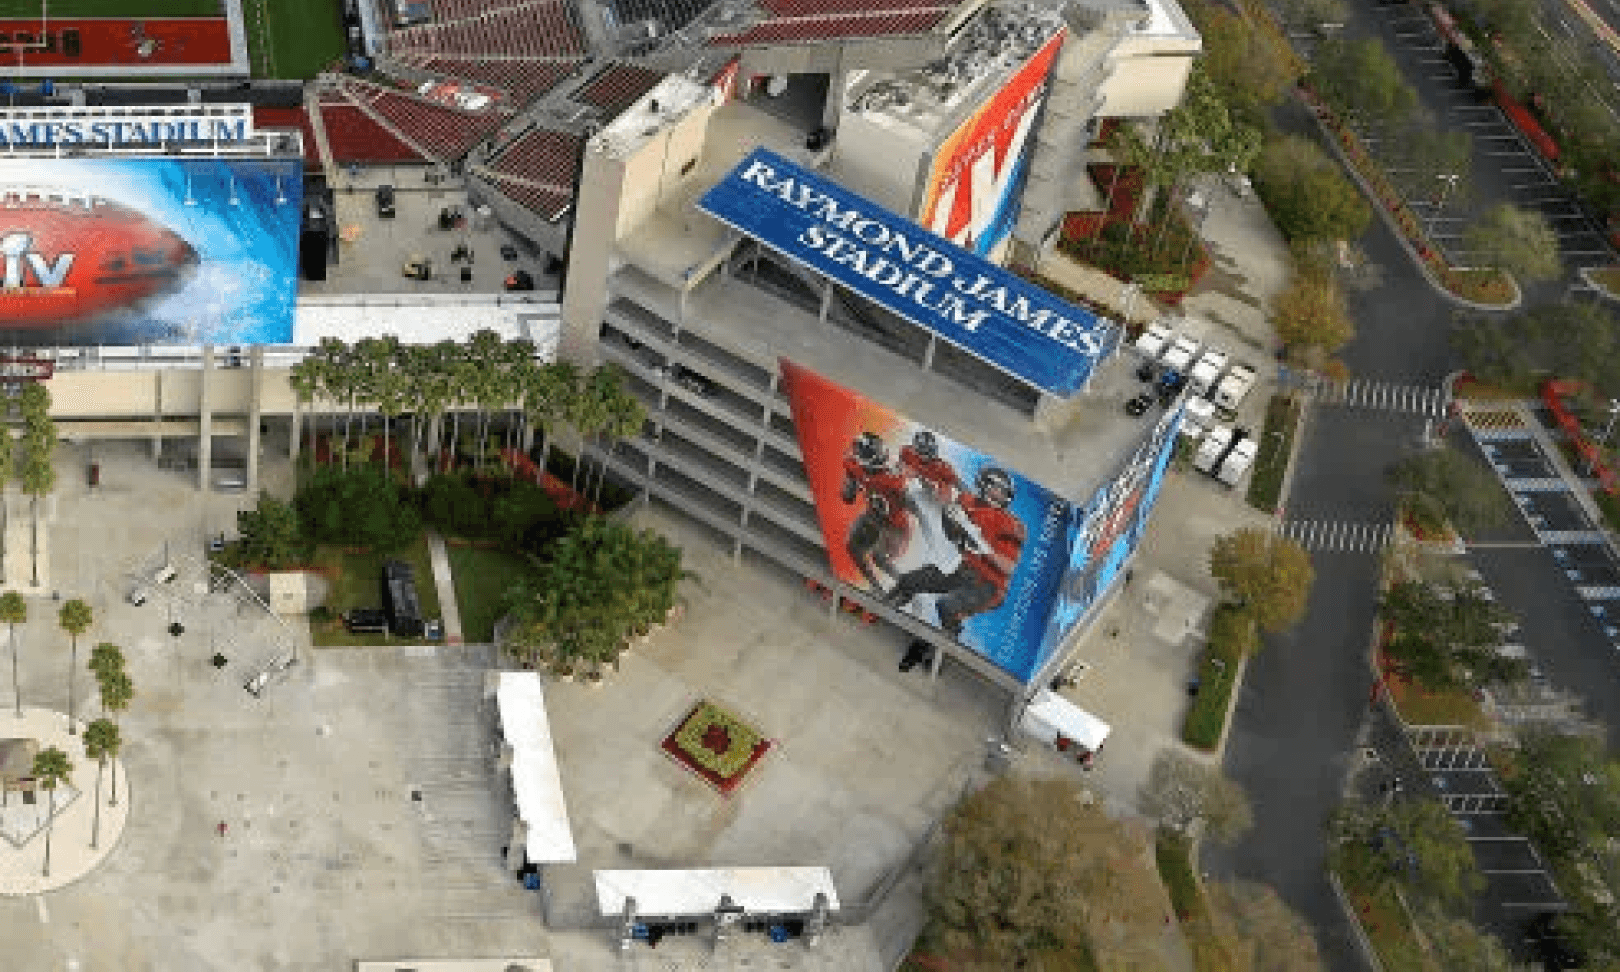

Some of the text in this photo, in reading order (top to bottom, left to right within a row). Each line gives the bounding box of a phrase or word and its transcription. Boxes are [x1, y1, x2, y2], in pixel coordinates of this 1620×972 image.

[91, 119, 246, 143] STADIUM
[740, 159, 1108, 356] RAYMOND JAMES
[799, 226, 987, 331] STADIUM
